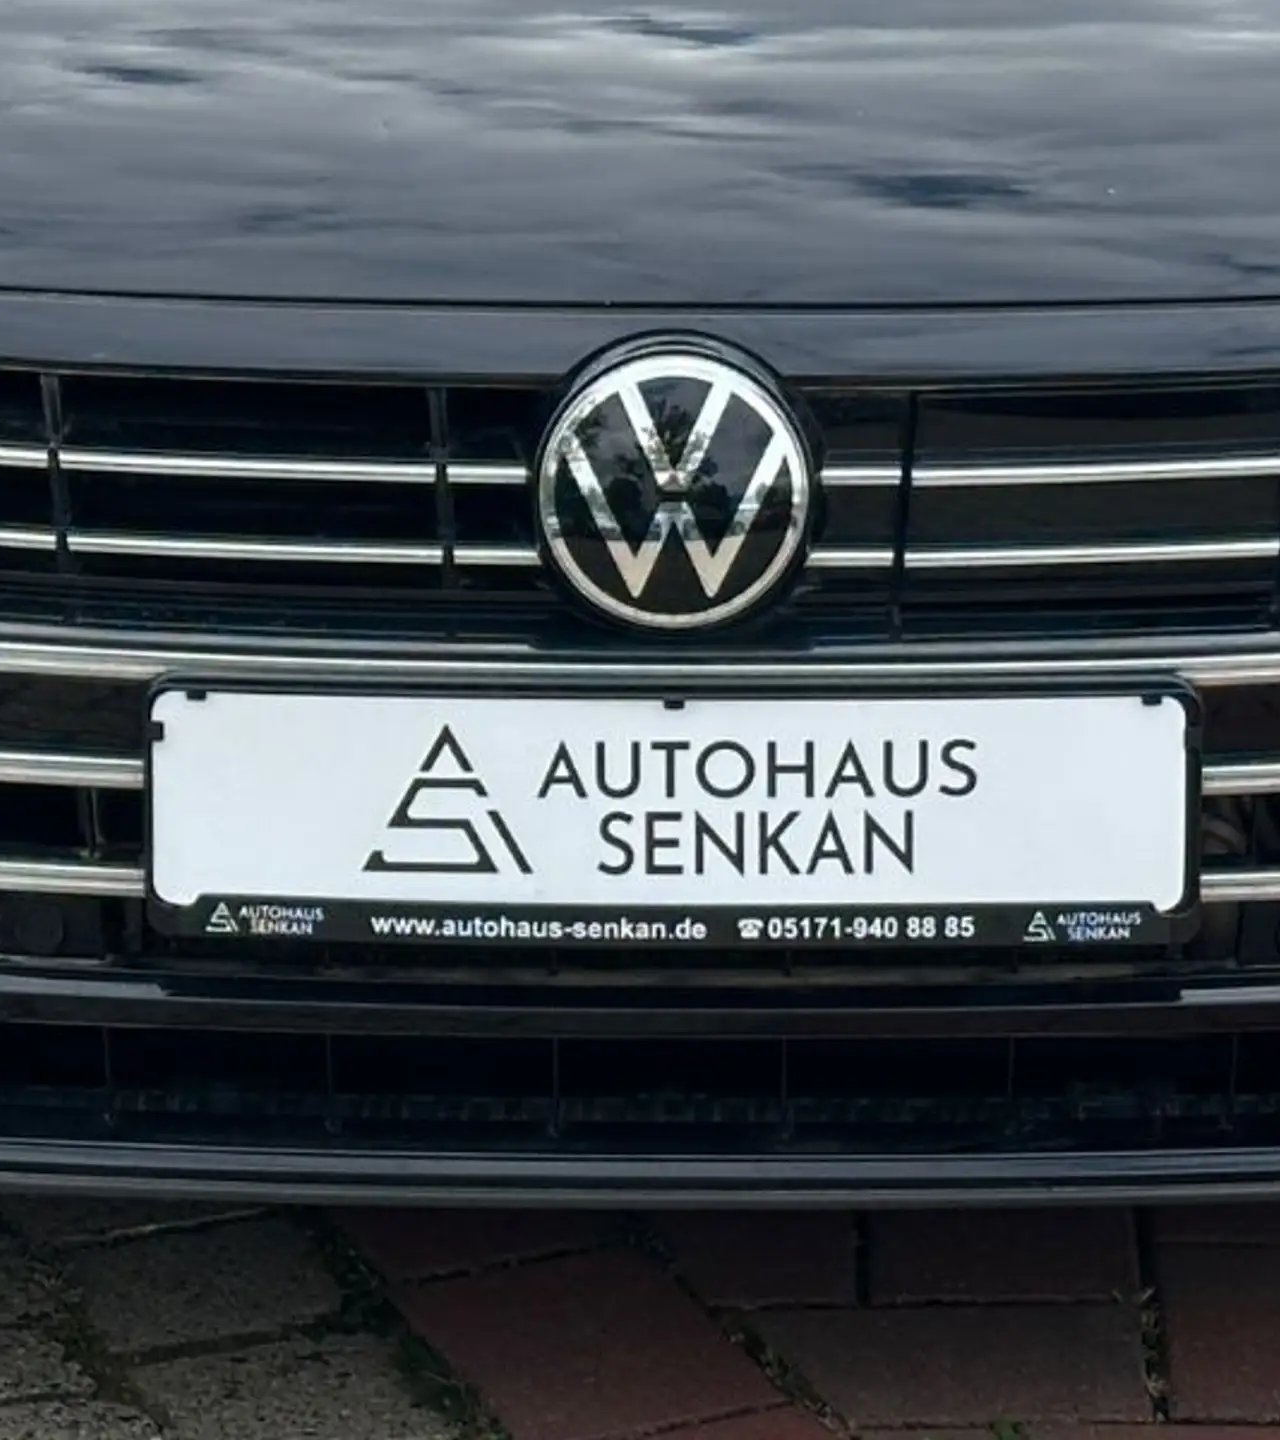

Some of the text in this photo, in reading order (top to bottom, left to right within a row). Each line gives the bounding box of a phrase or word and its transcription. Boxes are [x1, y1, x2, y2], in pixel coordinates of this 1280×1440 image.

[537, 738, 978, 800] AUTOHAUS
[597, 809, 915, 877] SENKAN
[239, 905, 325, 921] AUTOHAUS
[1056, 911, 1142, 927] AUTOHAUS
[250, 919, 314, 935] SENKAN
[371, 913, 708, 941] www.autohaus-senkan.de
[767, 916, 975, 940] 05171-940 88 85
[1067, 925, 1132, 941] SENKAN
